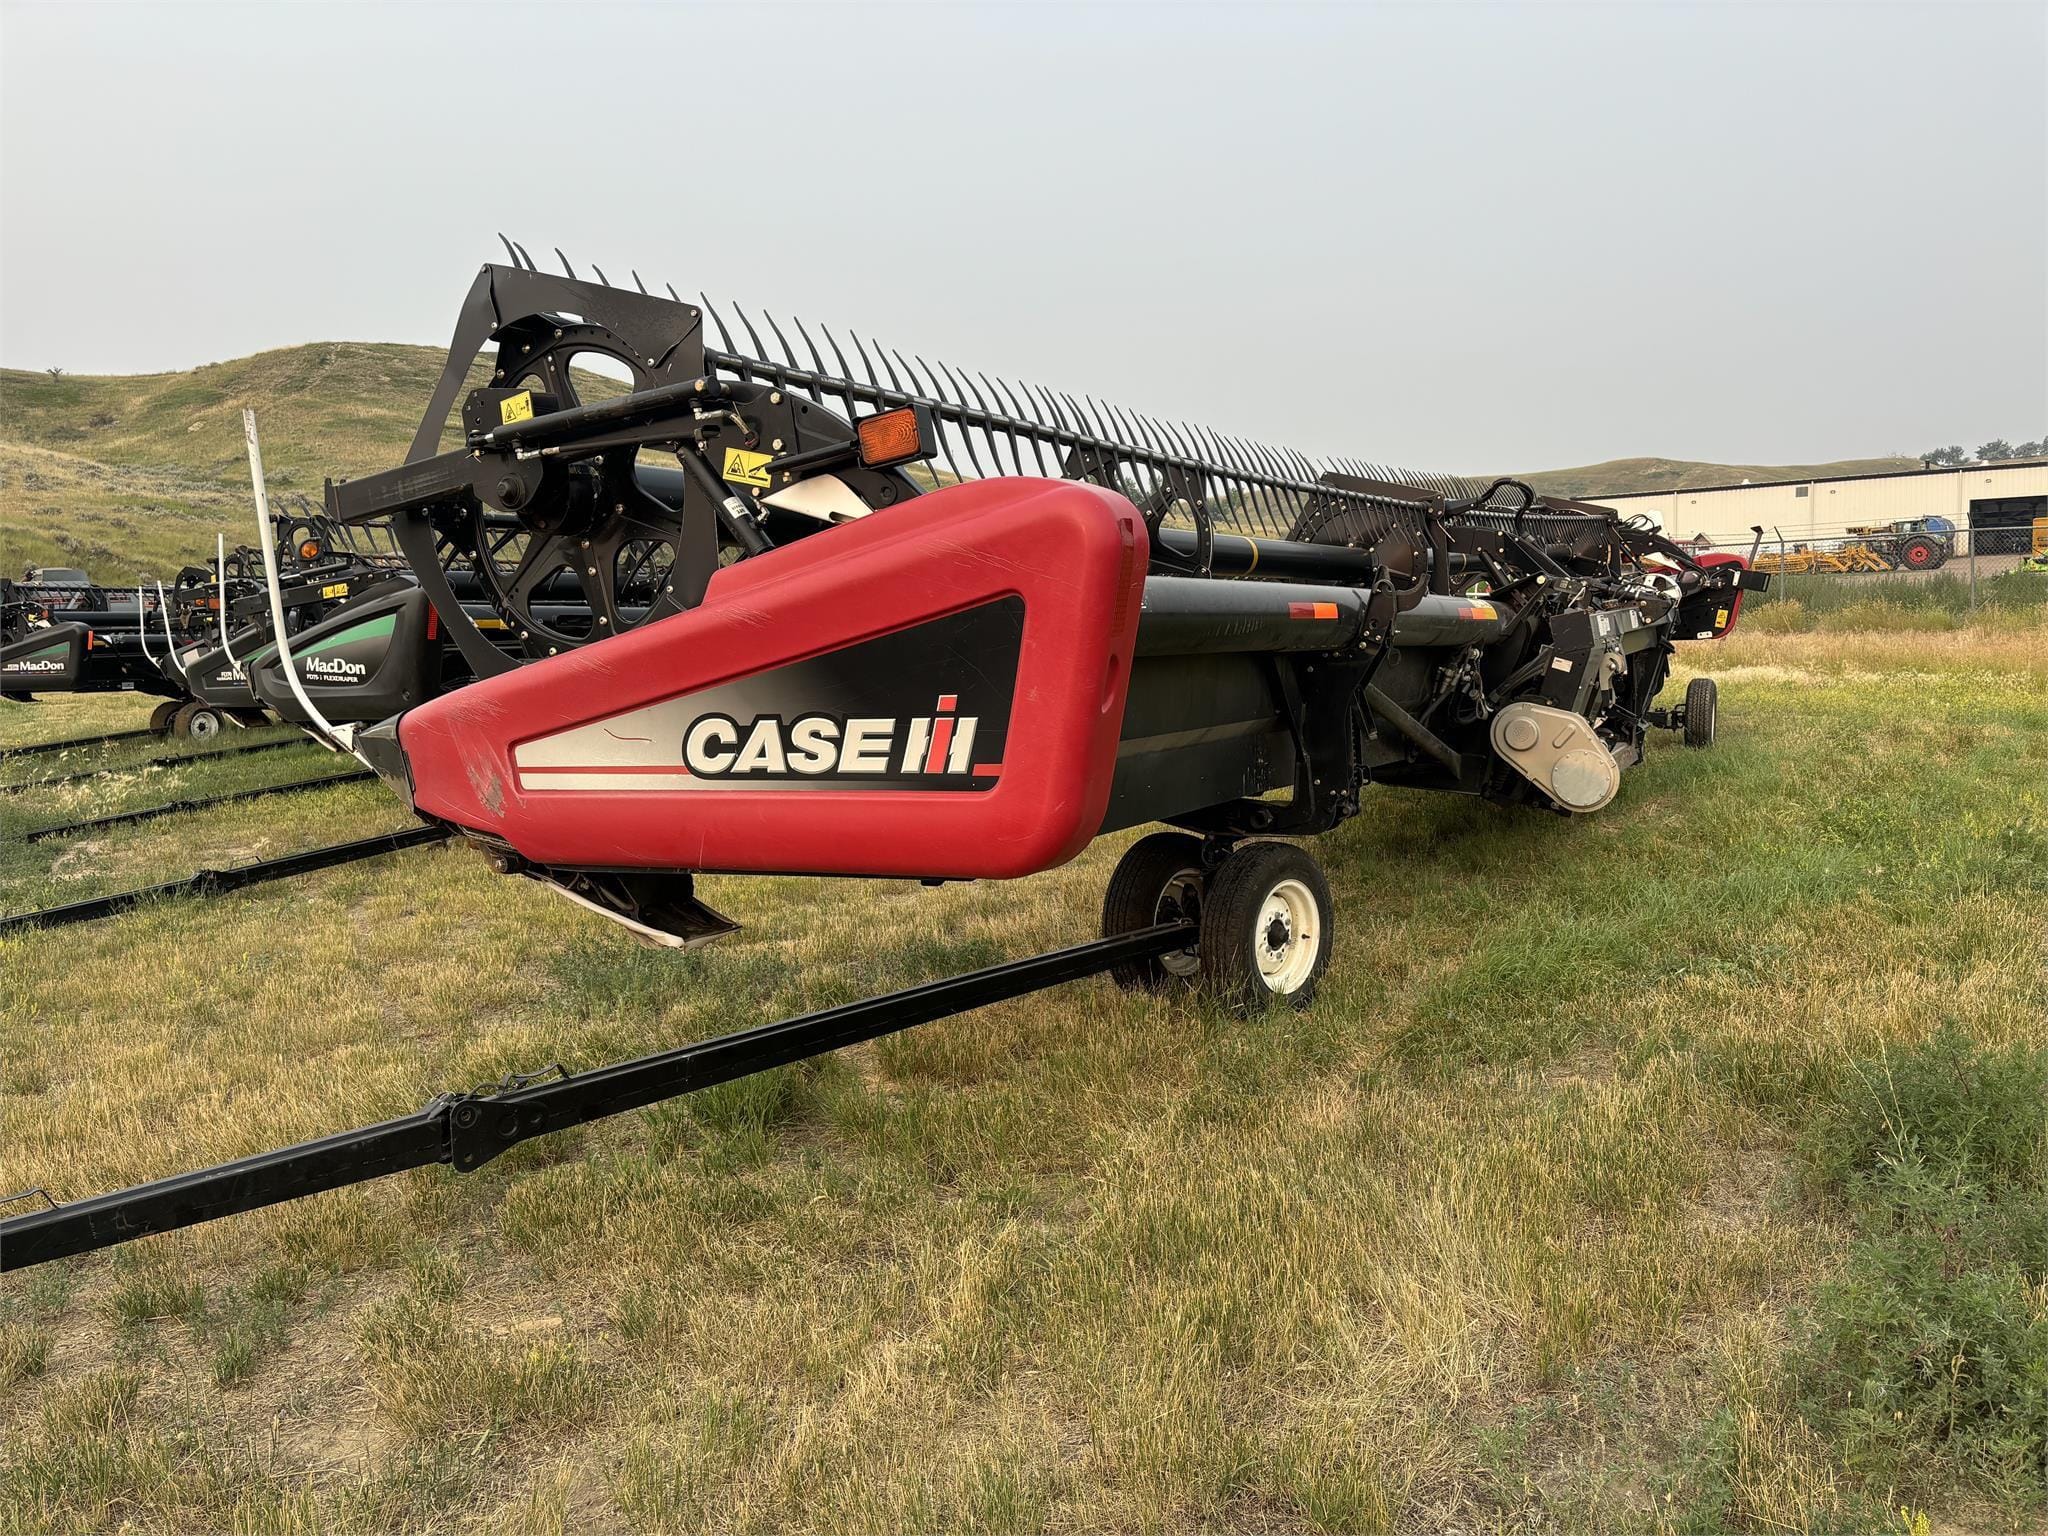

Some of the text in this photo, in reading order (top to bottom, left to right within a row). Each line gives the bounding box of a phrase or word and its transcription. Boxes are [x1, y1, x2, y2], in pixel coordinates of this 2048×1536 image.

[20, 660, 65, 671] MacDon
[306, 656, 366, 674] MacDon
[686, 717, 896, 774] CASE
